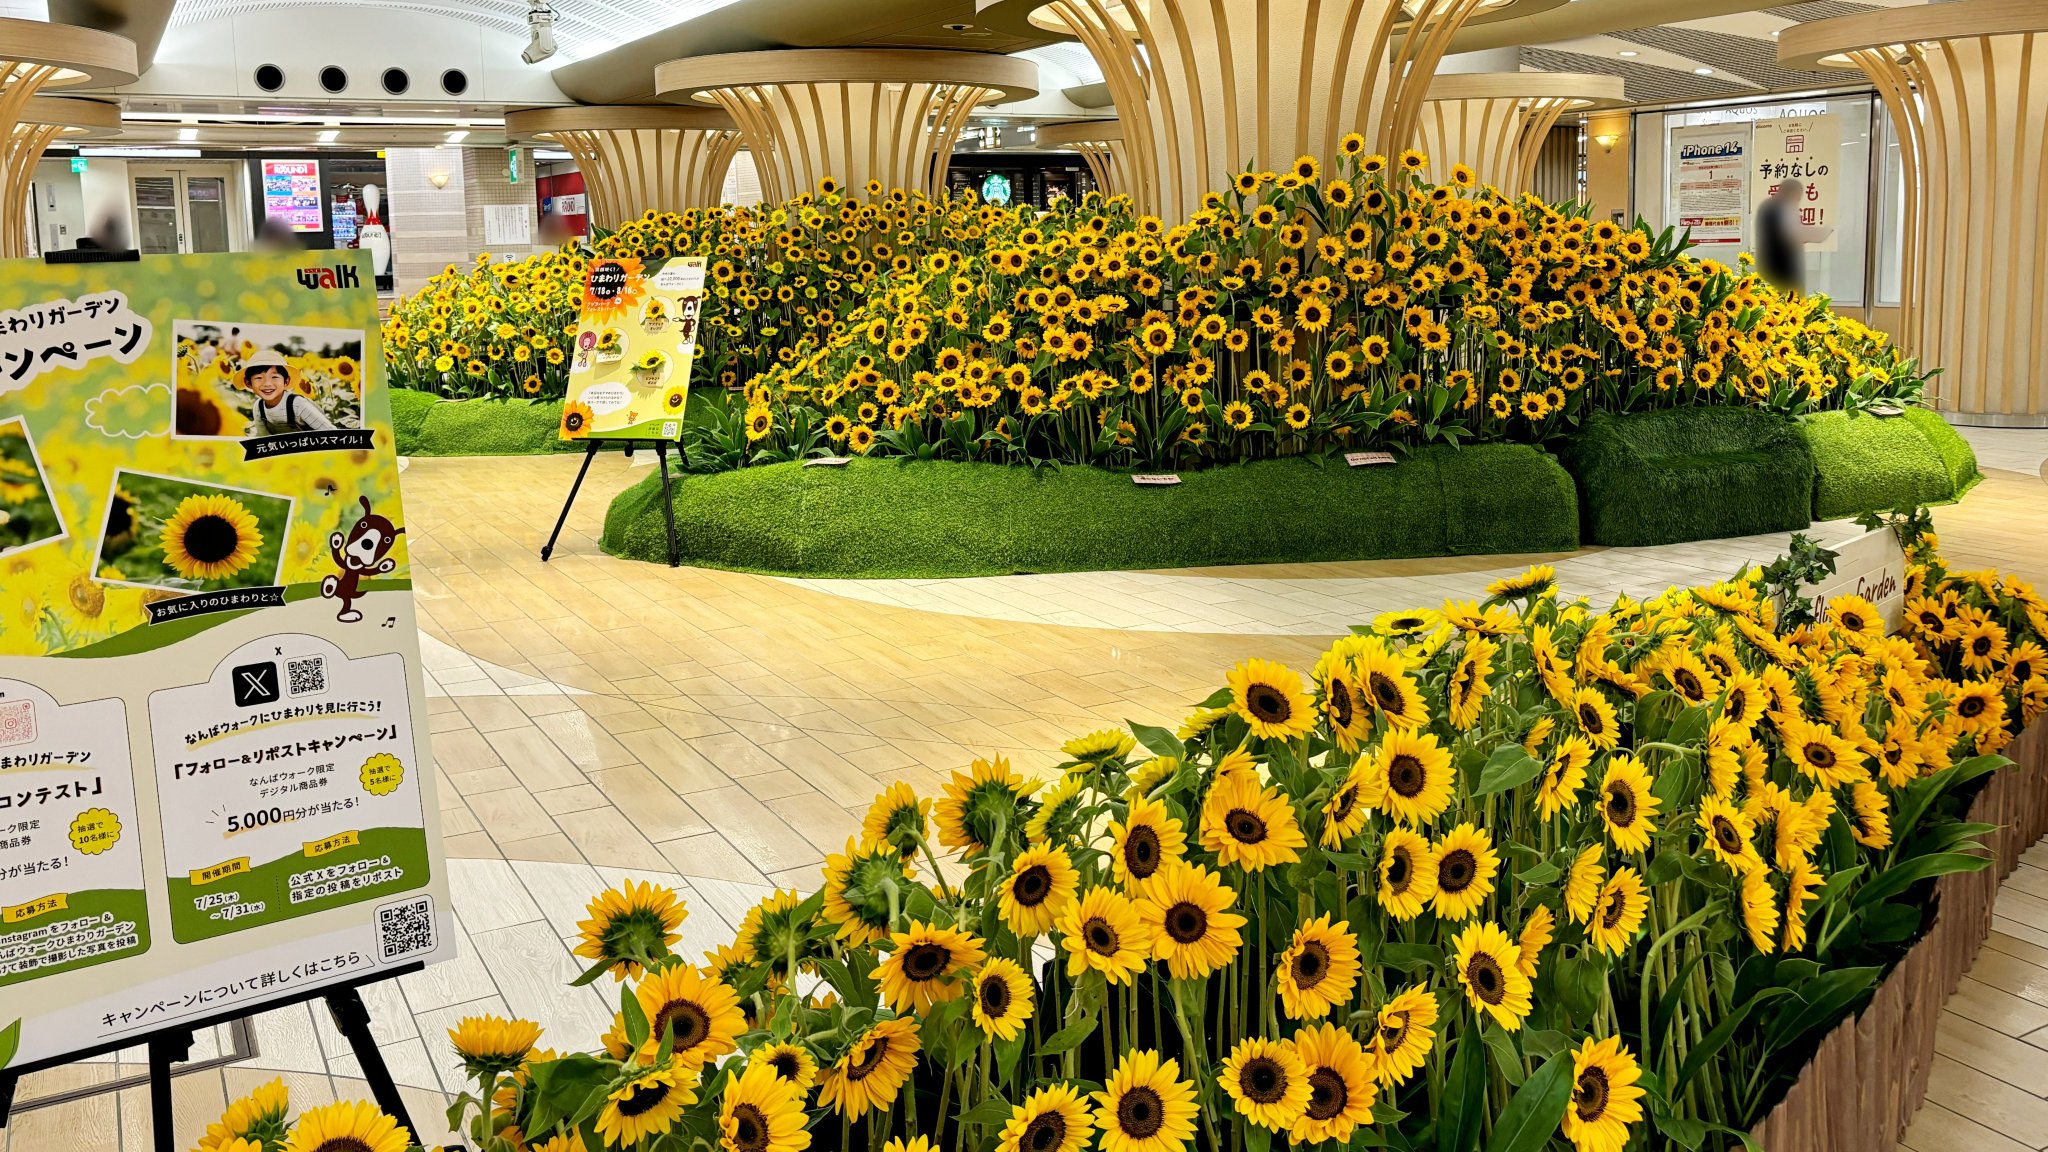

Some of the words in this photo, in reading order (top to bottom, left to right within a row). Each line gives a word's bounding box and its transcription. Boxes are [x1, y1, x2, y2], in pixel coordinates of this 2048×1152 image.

[1682, 145, 1722, 157] iPhone
[1724, 141, 1739, 154] 14
[1760, 162, 1829, 179] 予約なしの
[296, 264, 359, 290] walk
[591, 273, 650, 283] ひまわりガーデン
[0, 323, 142, 381] ンペーン
[256, 436, 363, 454] 元気いっぱいスマイル!
[184, 701, 382, 745] なんばウォークにひまわりを見に行こう!
[1, 752, 91, 769] まわりガーデン
[249, 763, 335, 787] なんばウォーク限定
[369, 765, 391, 776] 抽選で
[259, 778, 328, 799] デジタル商品券
[369, 775, 396, 786] 5名様に
[228, 797, 359, 833] 5,000円分が当たる!
[78, 821, 104, 834] 抽選で
[79, 831, 115, 845] 10名様に
[314, 836, 351, 853] 応募方法
[202, 862, 241, 881] 開催期間
[291, 869, 402, 902] 指定の投稿をリポスト
[15, 899, 58, 919] 応募方法
[0, 918, 98, 944] nstagramをフォロー
[102, 950, 360, 1028] キャンペーンについて詳しくはこちら
